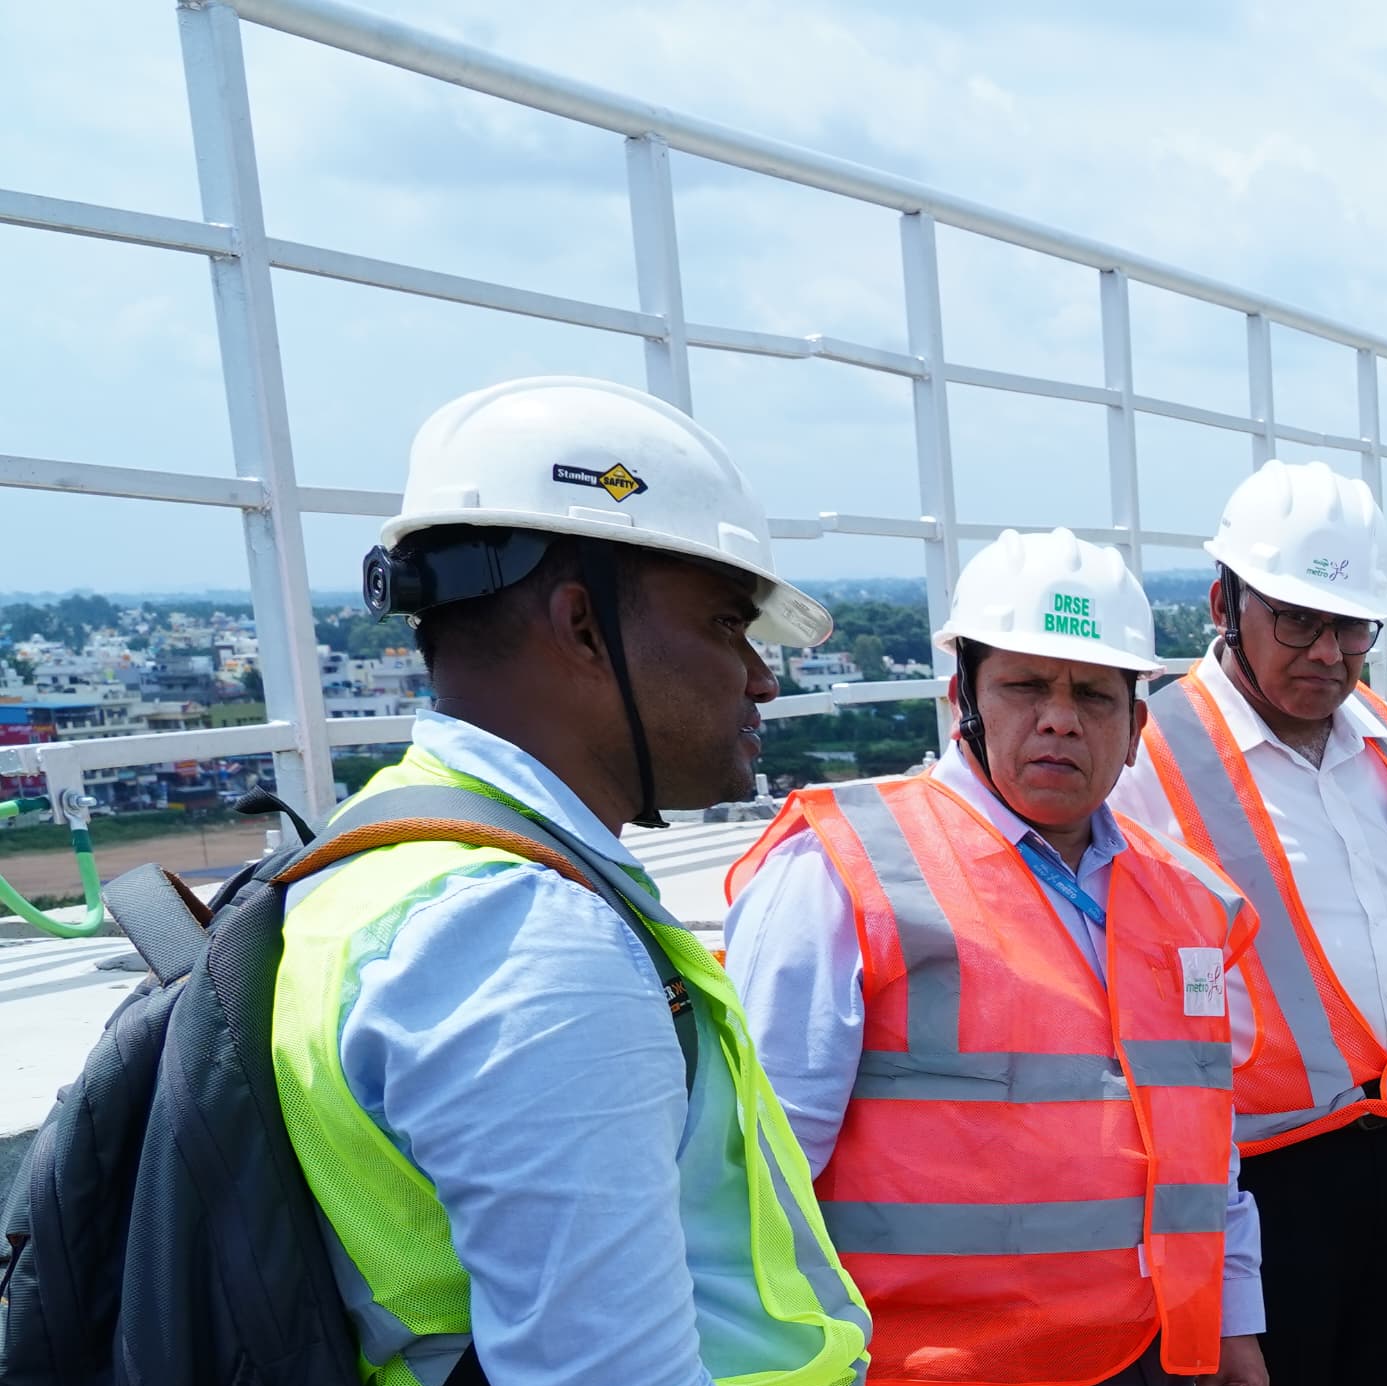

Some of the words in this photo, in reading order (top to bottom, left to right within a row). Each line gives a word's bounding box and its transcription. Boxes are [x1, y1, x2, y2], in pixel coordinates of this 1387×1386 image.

[557, 467, 598, 485] Stanley
[603, 476, 635, 489] SAFETY
[1054, 593, 1090, 617] DRSE
[1045, 613, 1101, 639] BMRCL
[1186, 983, 1209, 993] metro
